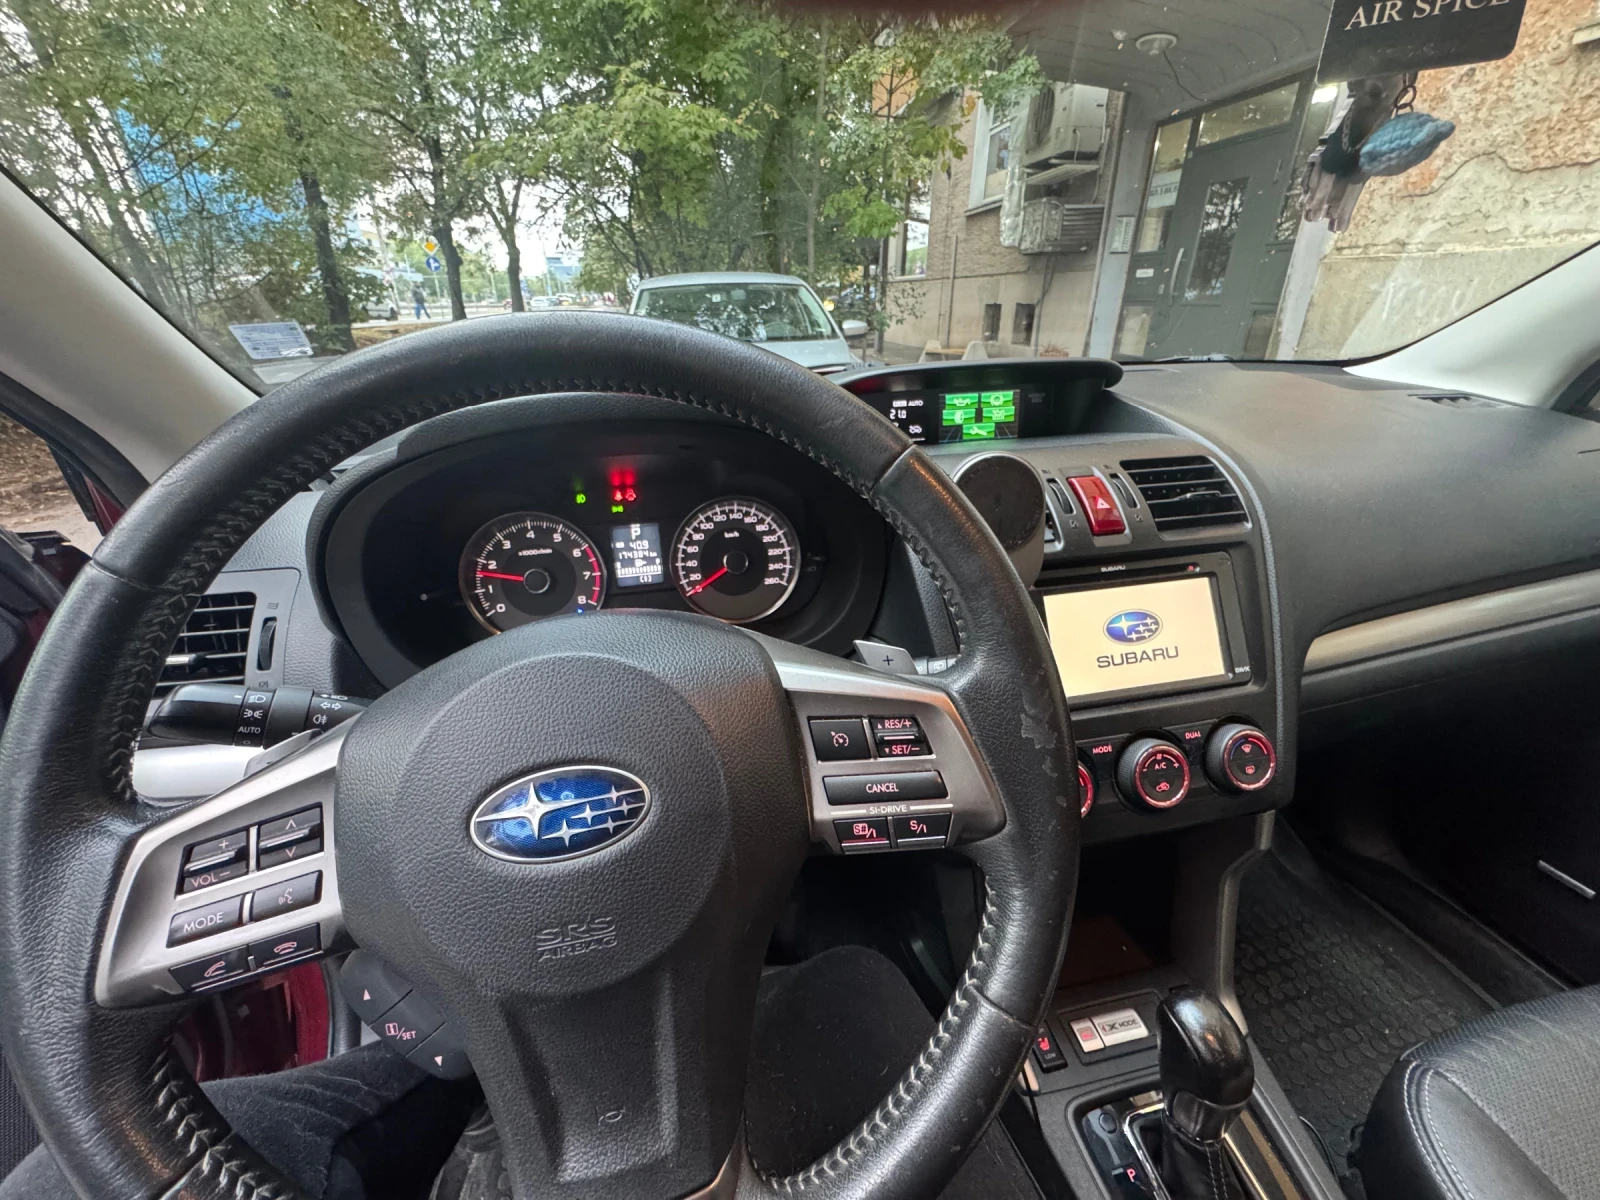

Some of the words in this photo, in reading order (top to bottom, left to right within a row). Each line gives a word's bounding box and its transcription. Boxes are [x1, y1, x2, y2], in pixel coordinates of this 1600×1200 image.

[1344, 0, 1403, 31] AIR
[1412, 0, 1510, 19] SPI
[713, 514, 727, 522] 120
[729, 512, 743, 520] 140
[744, 516, 758, 524] 160
[700, 522, 714, 530] 100
[755, 524, 769, 532] 180
[526, 530, 535, 539] 4
[553, 533, 562, 542] 5
[631, 528, 641, 540] P
[502, 540, 511, 549] 3
[572, 548, 582, 557] 6
[768, 548, 783, 556] 220
[487, 560, 497, 569] 2
[1101, 565, 1126, 573] SUBARU
[582, 571, 591, 580] 7
[689, 573, 701, 581] 20
[764, 577, 780, 585] 260
[488, 585, 493, 594] 1
[577, 596, 587, 604] 8
[496, 603, 506, 613] 0
[1096, 646, 1179, 669] SUBARU
[237, 726, 261, 735] AUTO
[1185, 731, 1202, 740] DUAL
[1092, 744, 1113, 755] MODE
[1154, 761, 1167, 770] A/C
[866, 782, 899, 793] CANCEL
[869, 804, 907, 814] SI-DRIVE
[191, 873, 218, 888] VOL
[183, 911, 224, 934] MODE
[536, 916, 615, 945] SRS
[1126, 1168, 1136, 1182] P
